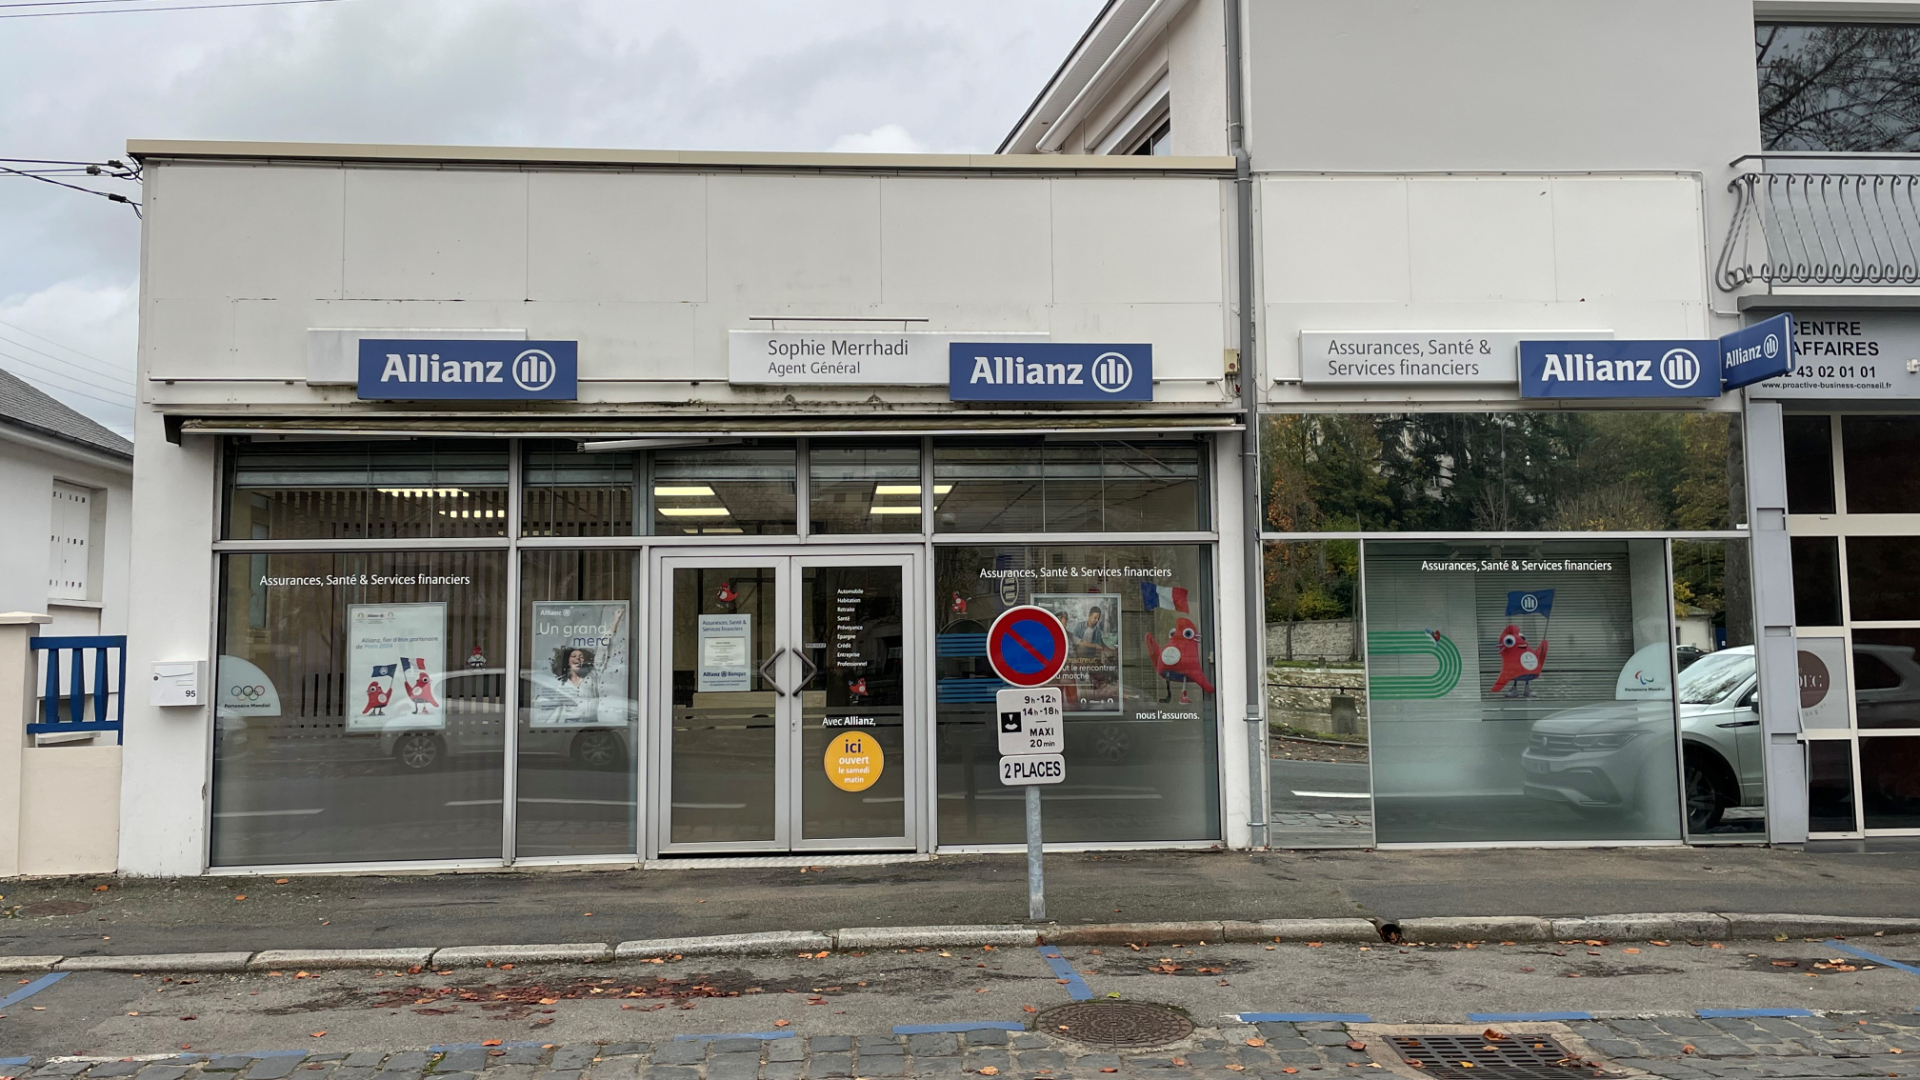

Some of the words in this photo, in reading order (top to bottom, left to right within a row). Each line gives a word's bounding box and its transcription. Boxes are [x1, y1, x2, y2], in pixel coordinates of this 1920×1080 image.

[768, 339, 826, 359] Sophie
[832, 339, 908, 356] Merrhadi
[1328, 339, 1424, 357] Assurances,
[1428, 339, 1474, 355] Santé
[1479, 339, 1492, 355] &
[1725, 344, 1762, 369] Allianz
[380, 353, 504, 383] Allianz
[768, 362, 806, 377] Agent
[810, 361, 860, 374] Général
[970, 356, 1084, 385] Allianz
[1328, 360, 1395, 376] Services
[1400, 359, 1479, 376] financiers
[1541, 353, 1653, 382] Allianz
[1797, 366, 1814, 378] 43
[1818, 366, 1835, 378] 02
[1839, 366, 1854, 378] 01
[1860, 366, 1876, 378] 01
[980, 568, 1038, 579] Assurances,
[1040, 567, 1068, 577] Santé
[1070, 567, 1079, 577] &
[1081, 567, 1122, 577] Services
[1124, 566, 1172, 577] financiers
[1421, 560, 1480, 572] Assurances,
[1482, 560, 1509, 571] Santé
[1511, 561, 1519, 571] &
[1522, 560, 1562, 571] Services
[1564, 560, 1612, 570] financiers
[260, 575, 324, 587] Assurances,
[326, 574, 357, 585] Santé
[360, 574, 368, 585] &
[370, 574, 416, 585] Services
[418, 573, 470, 585] financiers
[540, 622, 559, 634] Un
[564, 622, 607, 637] grand
[573, 637, 611, 646] merci
[185, 690, 196, 698] 95
[822, 717, 842, 726] Avec
[844, 716, 876, 726] Allianz,
[1157, 710, 1200, 720] l'assurons.
[1030, 727, 1054, 736] MAXI
[838, 756, 869, 764] ouvert
[1004, 763, 1011, 778] 2
[1014, 761, 1061, 778] PLACES
